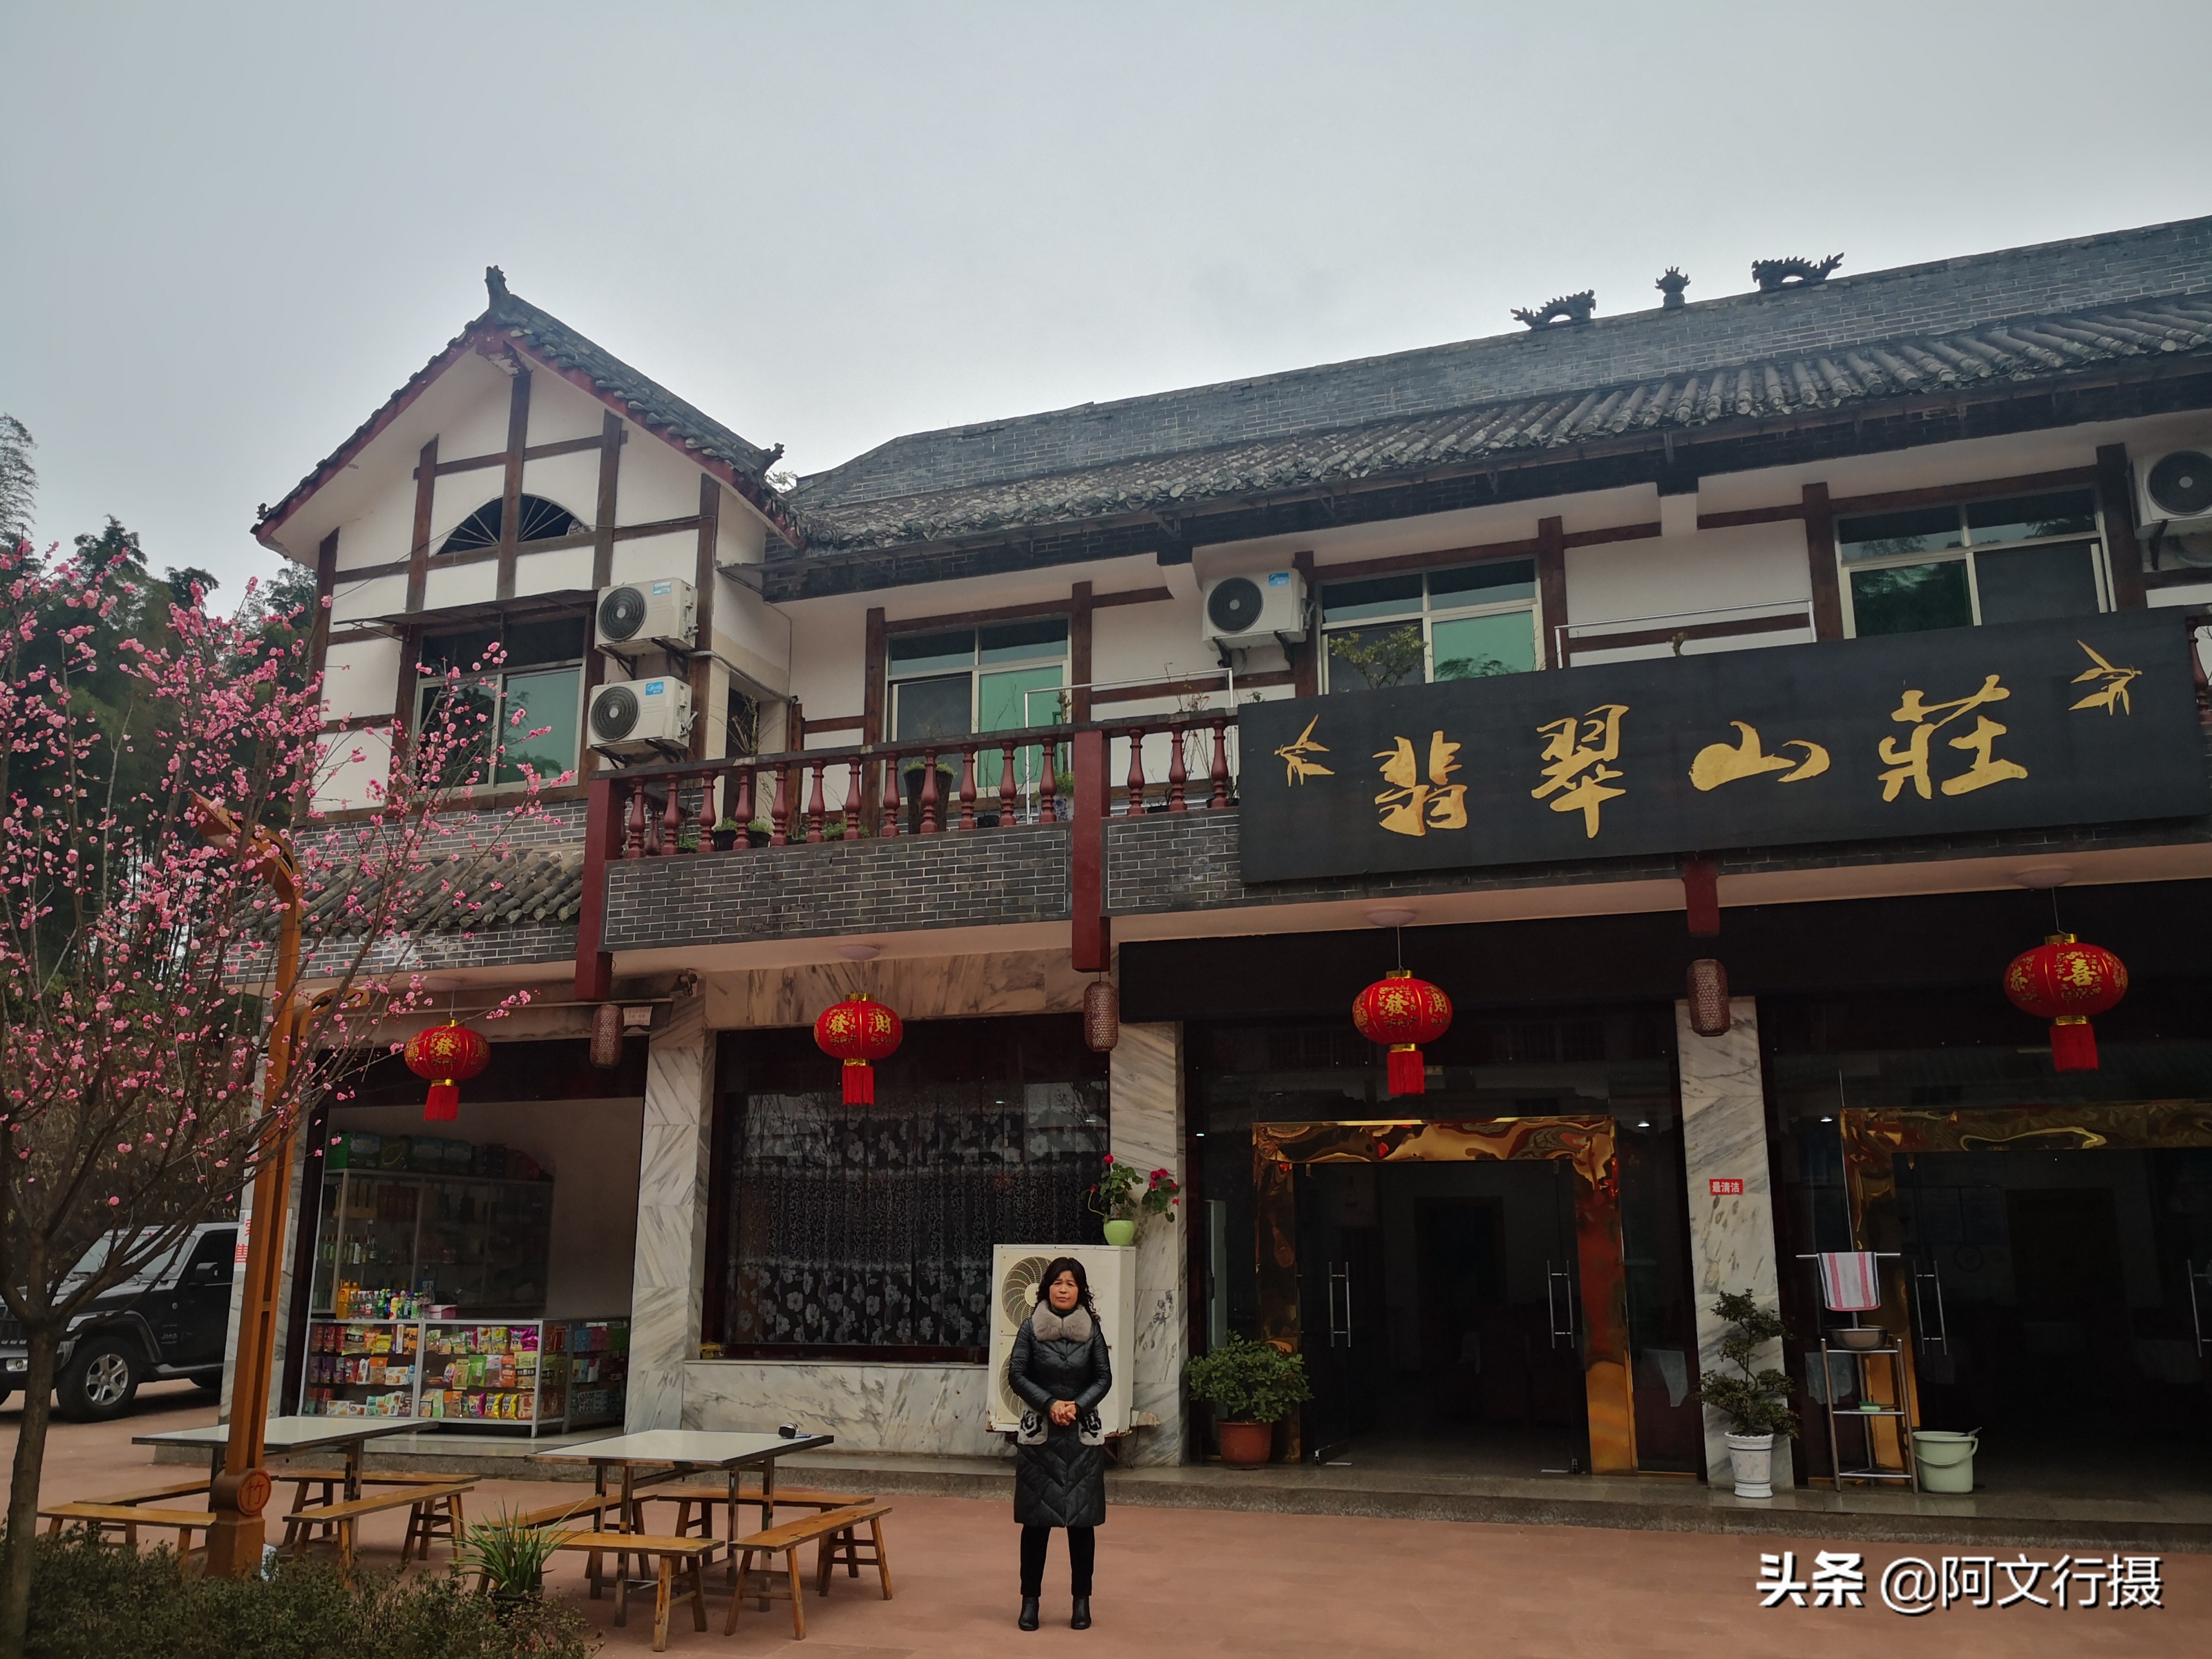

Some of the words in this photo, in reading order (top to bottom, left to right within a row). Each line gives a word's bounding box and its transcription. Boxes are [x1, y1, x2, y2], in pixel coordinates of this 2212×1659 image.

[2062, 958, 2098, 987] 喜
[875, 1015, 891, 1035] 財
[1711, 1181, 1740, 1193] 最清洁
